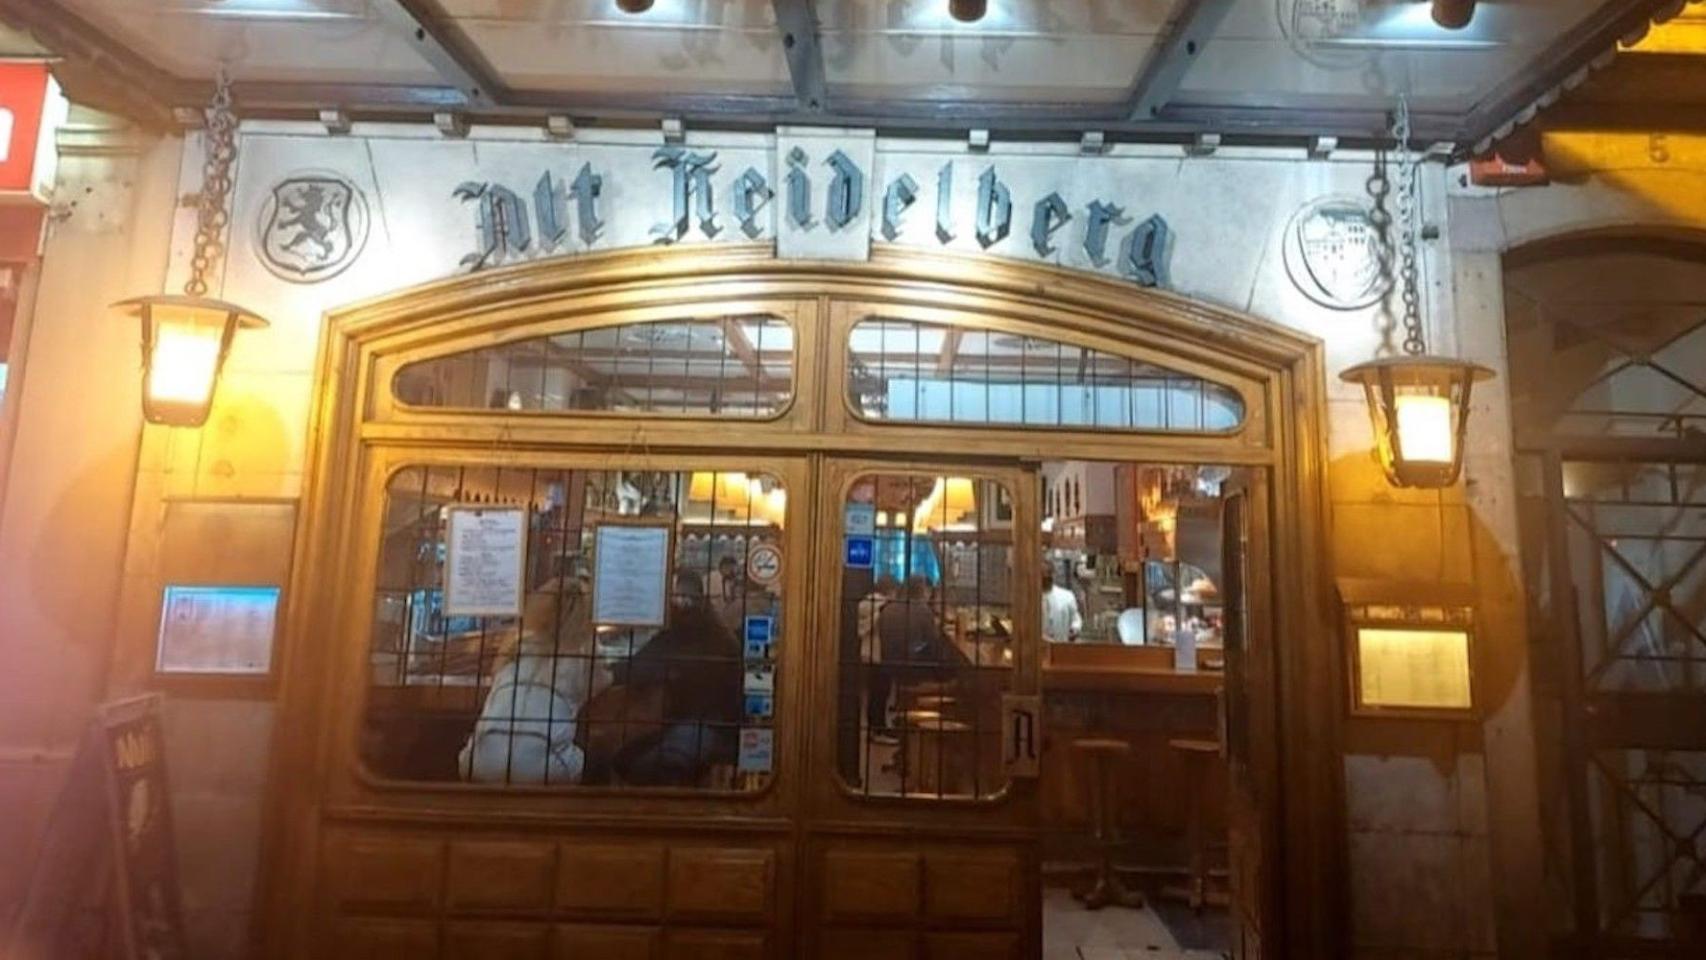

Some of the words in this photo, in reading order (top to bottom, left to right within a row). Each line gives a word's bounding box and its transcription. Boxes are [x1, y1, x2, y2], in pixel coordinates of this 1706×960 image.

[1649, 134, 1671, 164] 5
[452, 161, 605, 272] Alt
[650, 147, 1175, 287] Heidelberg
